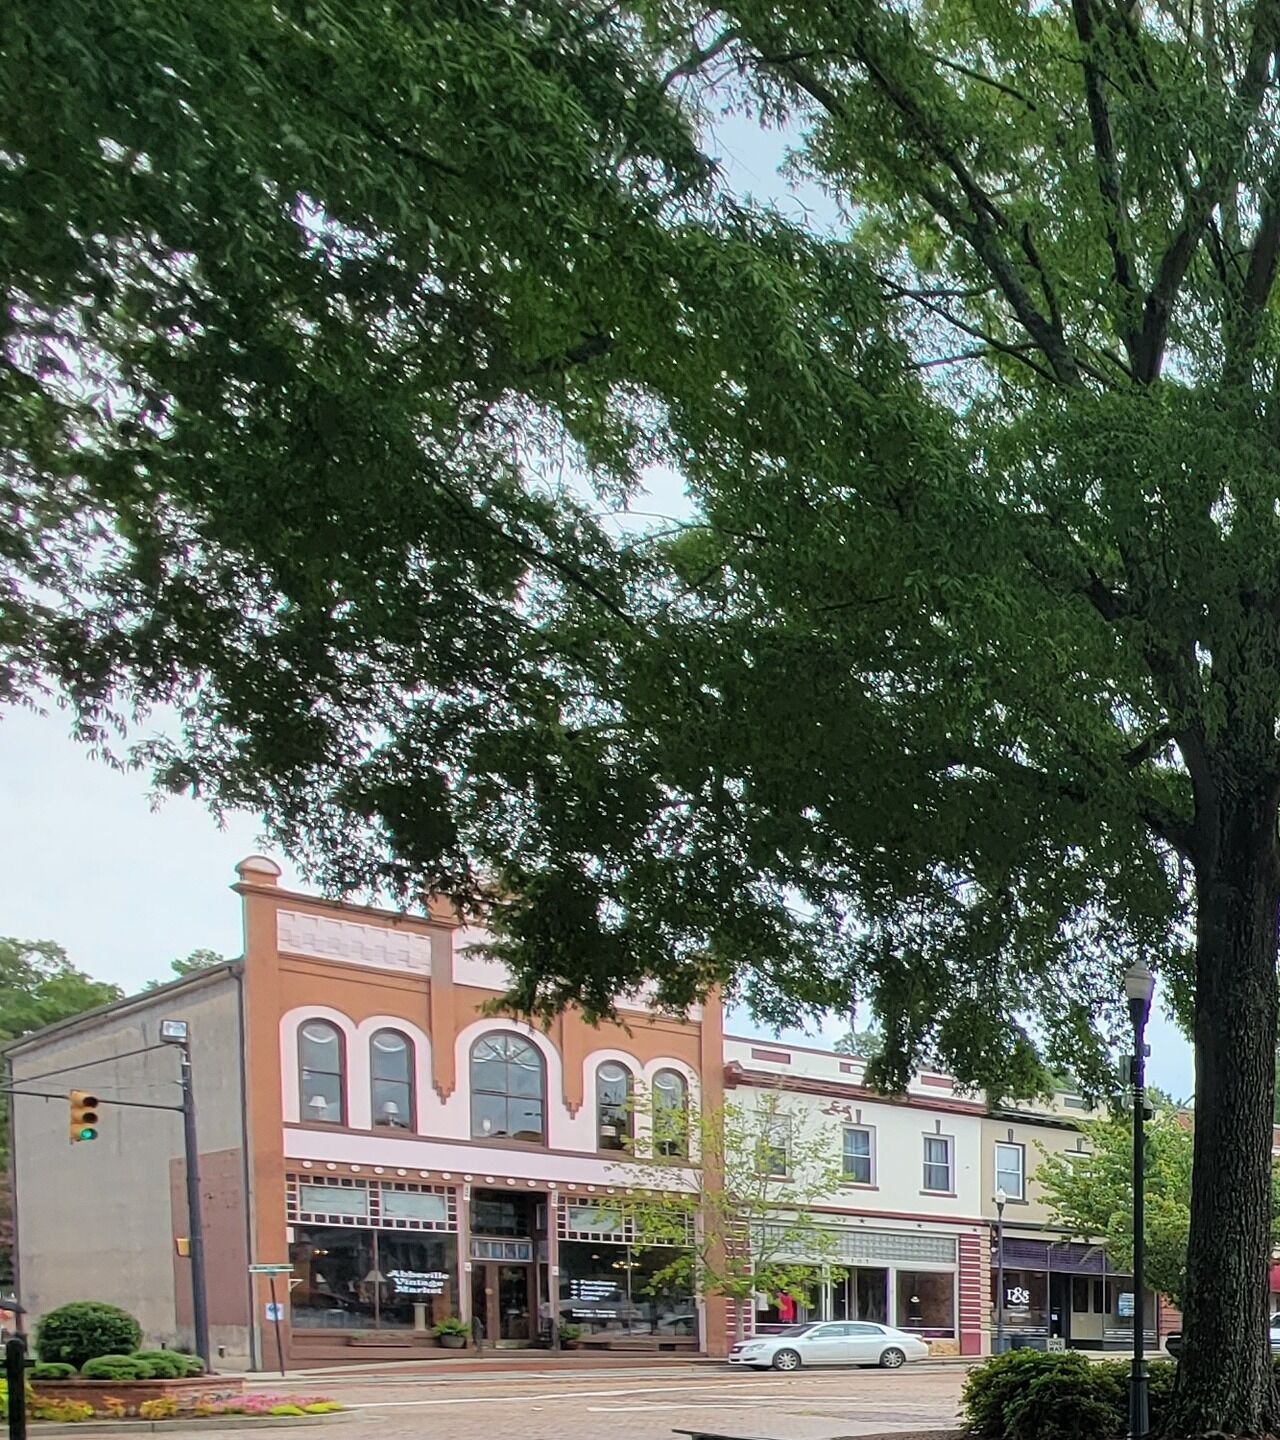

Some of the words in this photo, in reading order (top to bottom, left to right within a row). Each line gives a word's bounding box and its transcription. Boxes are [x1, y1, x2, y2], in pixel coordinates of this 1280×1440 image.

[386, 1269, 450, 1280] Abbeville
[393, 1277, 444, 1288] Vintage
[393, 1285, 443, 1294] Market
